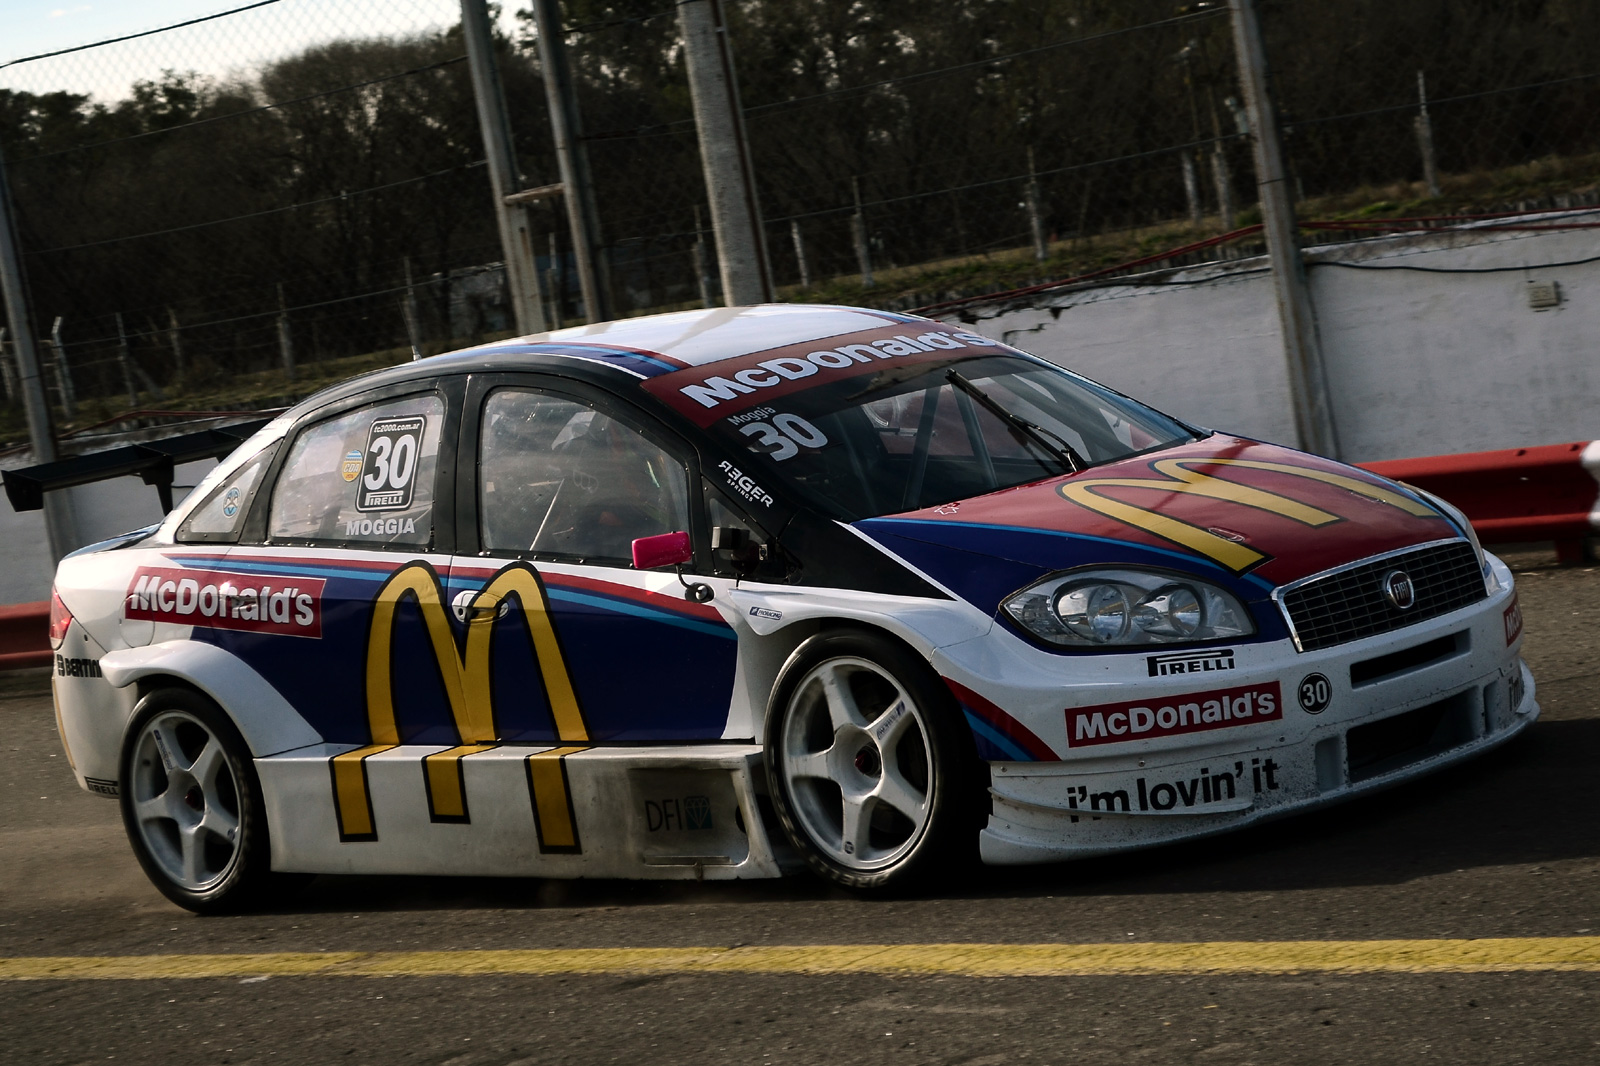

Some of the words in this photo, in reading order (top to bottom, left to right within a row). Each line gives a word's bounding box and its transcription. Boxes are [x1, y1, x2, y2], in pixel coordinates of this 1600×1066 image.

[679, 331, 997, 410] McDonald's
[727, 406, 777, 426] Moggia
[738, 413, 829, 462] 30
[364, 434, 416, 491] 30
[364, 490, 404, 507] PIRELLI
[726, 478, 754, 502] SPRINGS
[345, 518, 415, 536] MOGGIA
[130, 574, 315, 627] McDonald's
[1393, 580, 1410, 601] FIAT
[1146, 649, 1235, 677] PIRELLI
[1302, 680, 1328, 708] 30
[1074, 691, 1277, 741] McDonald's
[84, 775, 119, 796] PIRELL
[1067, 785, 1131, 823] i'm
[1136, 760, 1243, 812] lovin'
[1252, 757, 1280, 794] it
[644, 798, 683, 832] DFI
